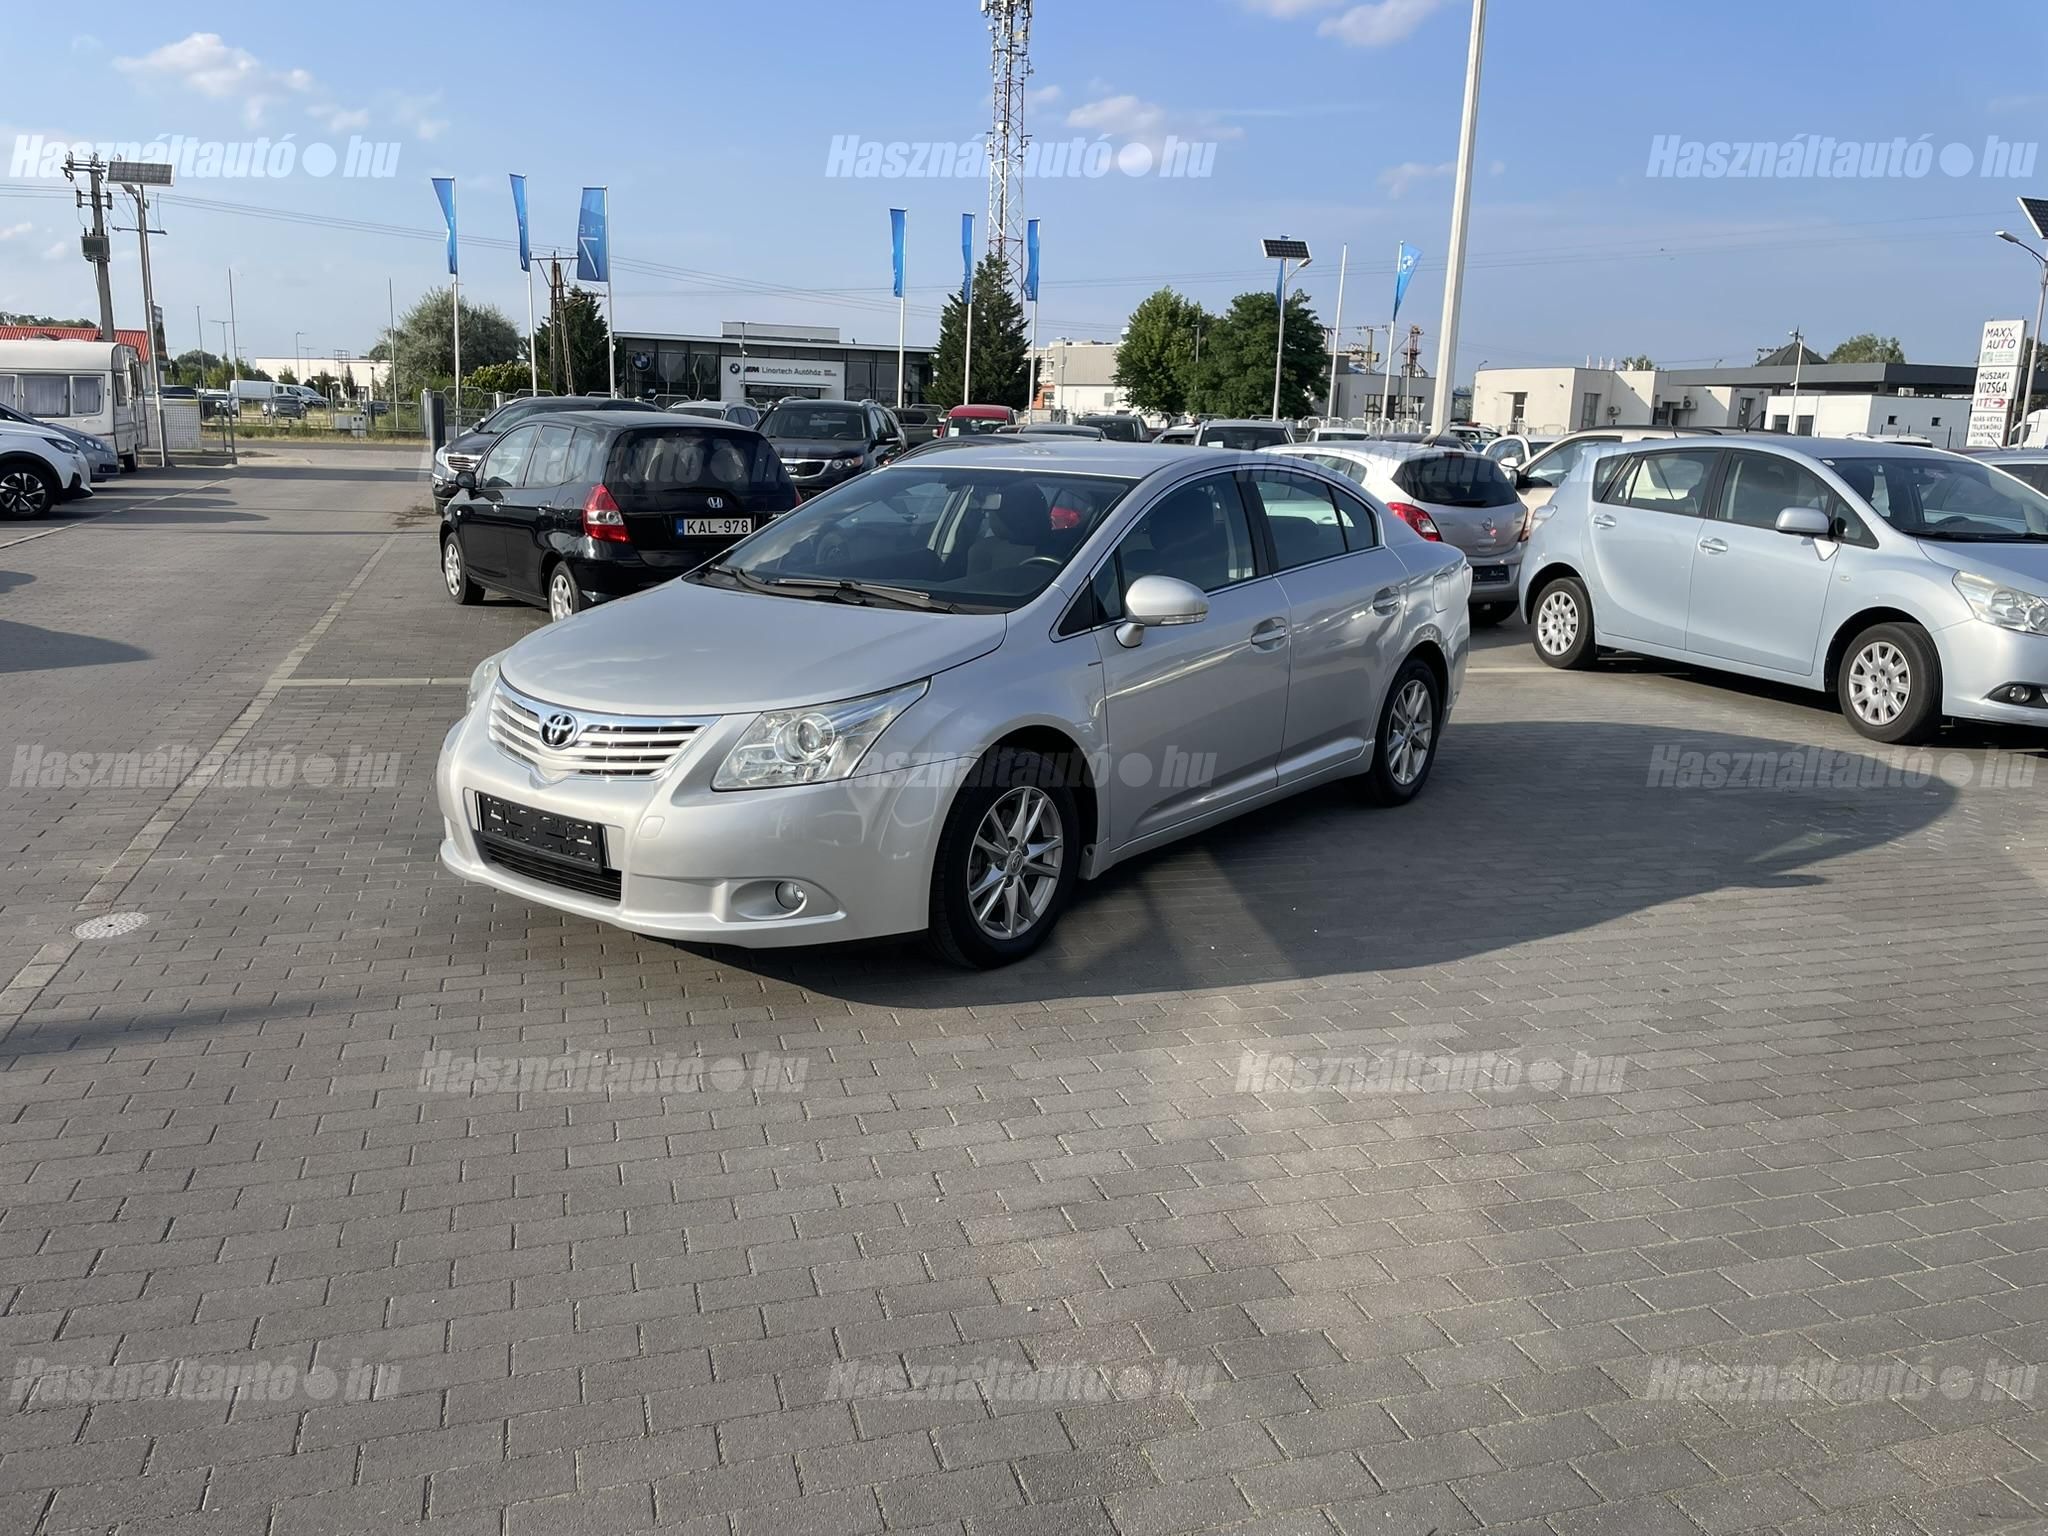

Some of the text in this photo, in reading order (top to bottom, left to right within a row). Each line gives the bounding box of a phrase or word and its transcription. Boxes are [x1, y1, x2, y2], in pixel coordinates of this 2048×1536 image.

[1985, 325, 2016, 338] MAXX
[1986, 338, 2016, 350] AUTO
[761, 367, 793, 375] Linortech
[1978, 381, 2007, 394] VIZSGA
[687, 520, 749, 534] KAL-978
